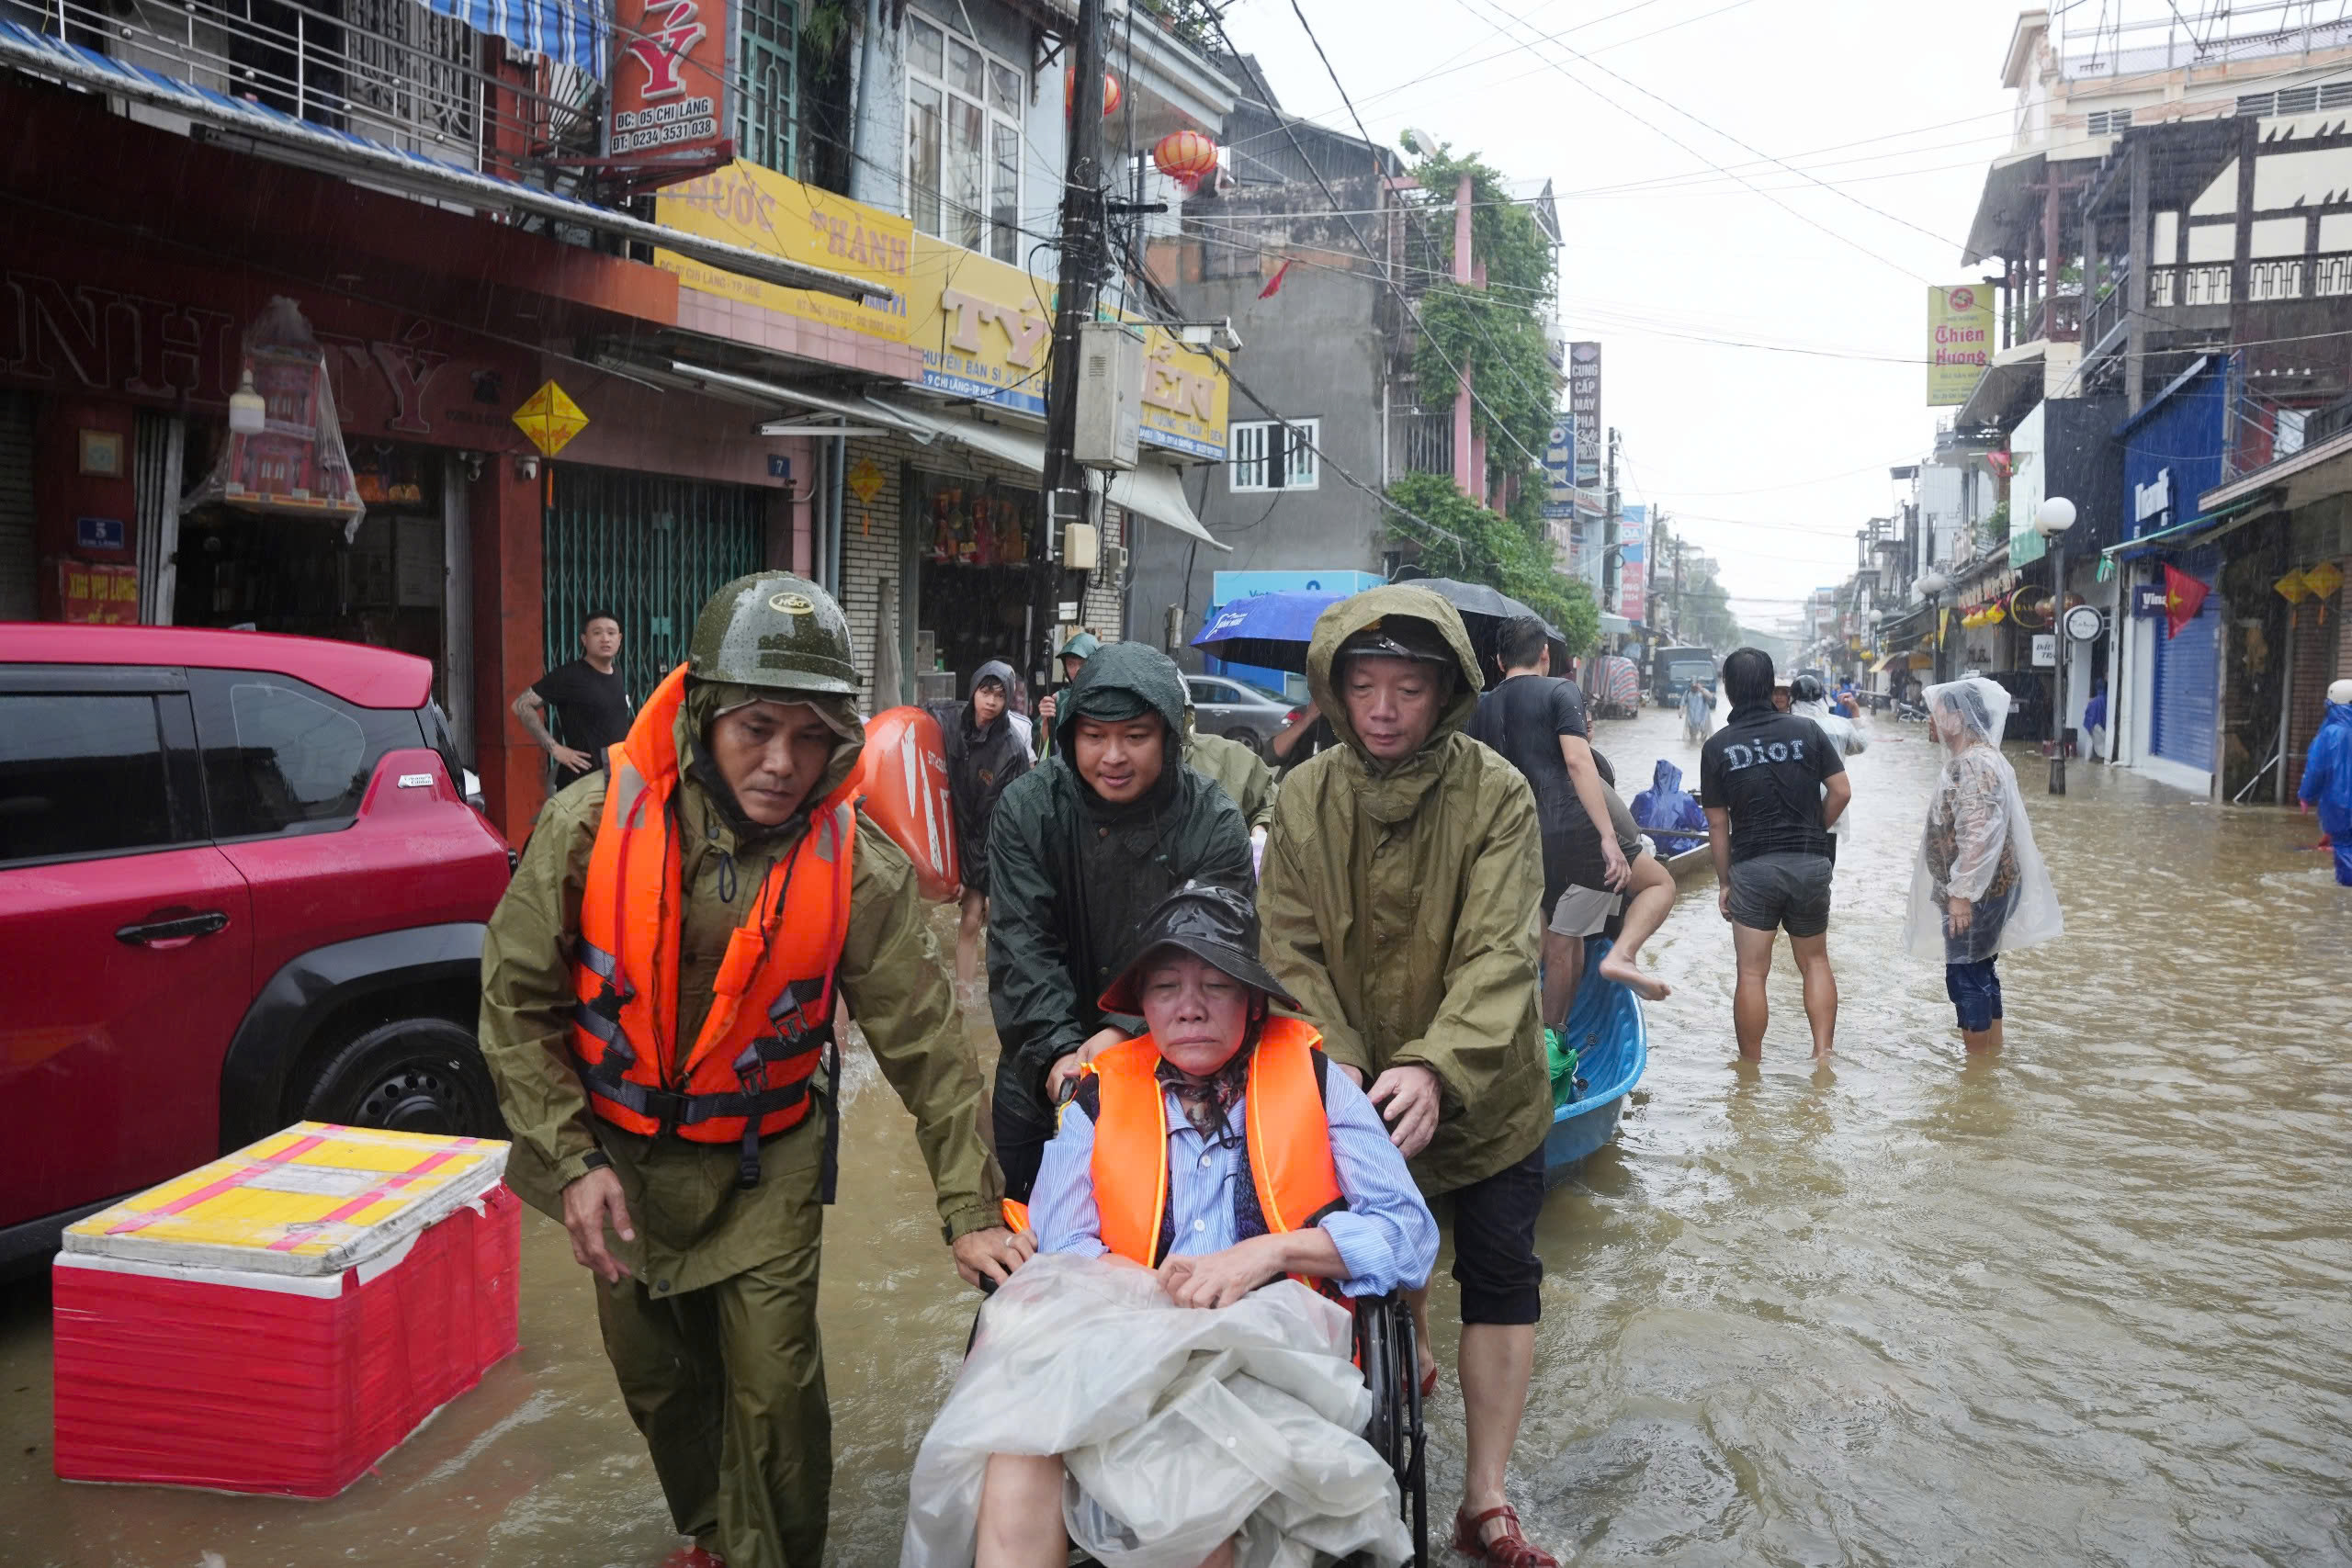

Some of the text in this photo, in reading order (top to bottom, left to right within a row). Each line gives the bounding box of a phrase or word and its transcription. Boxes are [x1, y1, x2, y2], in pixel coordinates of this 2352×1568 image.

[625, 0, 707, 100] Ý
[617, 113, 635, 129] ĐC:
[639, 111, 652, 125] 05
[656, 107, 674, 121] CHI
[633, 131, 659, 147] 0234
[663, 126, 687, 141] 3531
[692, 120, 711, 135] 038
[922, 349, 962, 371] HUYÊN
[1572, 365, 1598, 378] CUNG
[1575, 378, 1595, 394] CẤP
[1574, 396, 1596, 411] MÁY
[1577, 415, 1595, 428] PHA
[776, 459, 784, 475] 7
